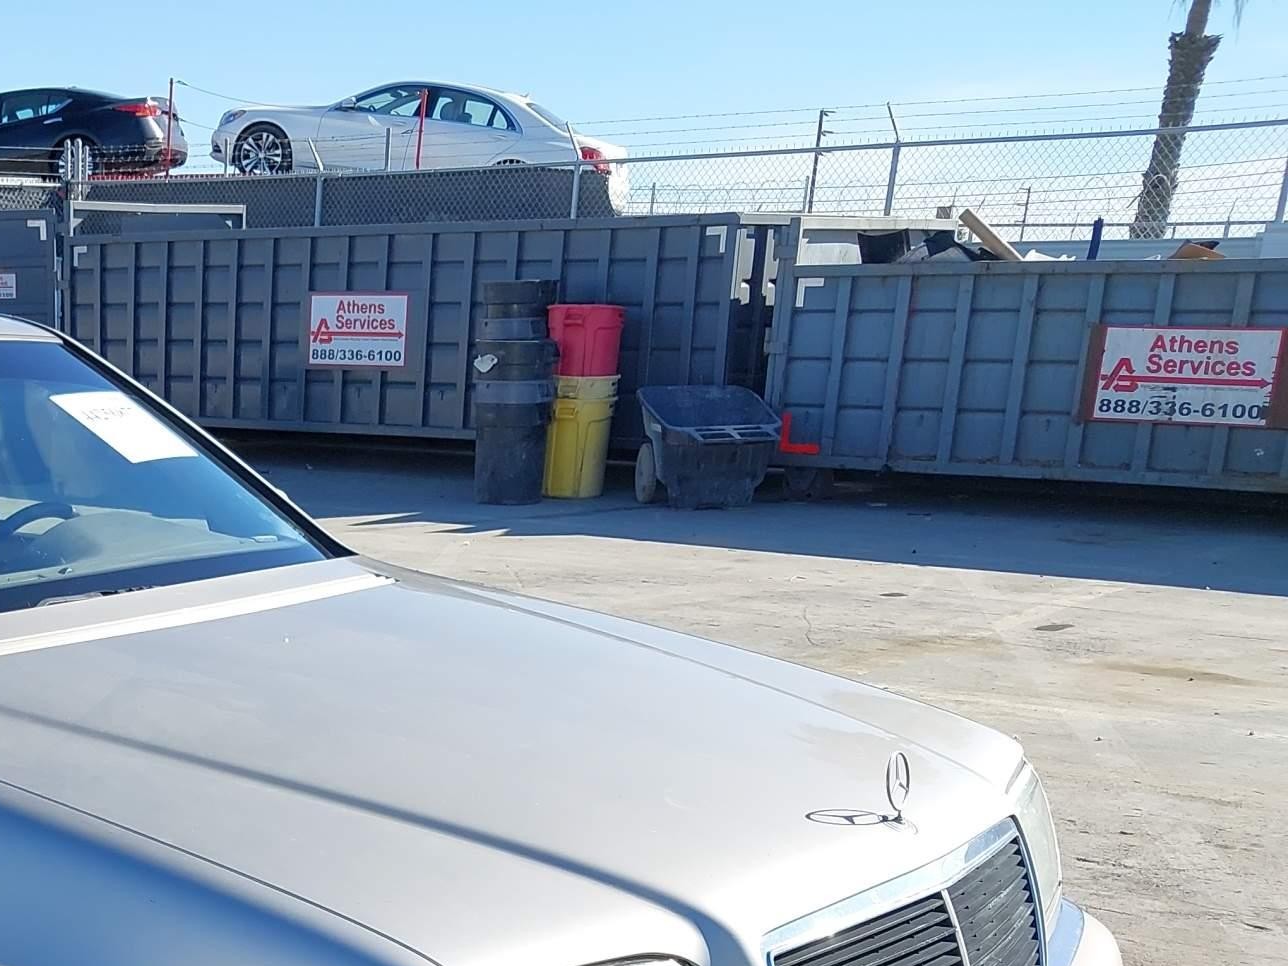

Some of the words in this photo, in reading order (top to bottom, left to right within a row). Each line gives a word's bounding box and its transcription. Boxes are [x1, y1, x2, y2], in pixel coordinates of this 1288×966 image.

[336, 300, 385, 314] Athens
[335, 315, 396, 330] Services
[1149, 334, 1240, 355] Athens
[311, 348, 402, 362] 888/336-6100
[1146, 354, 1257, 377] Services
[1098, 398, 1264, 420] 888/336-6100
